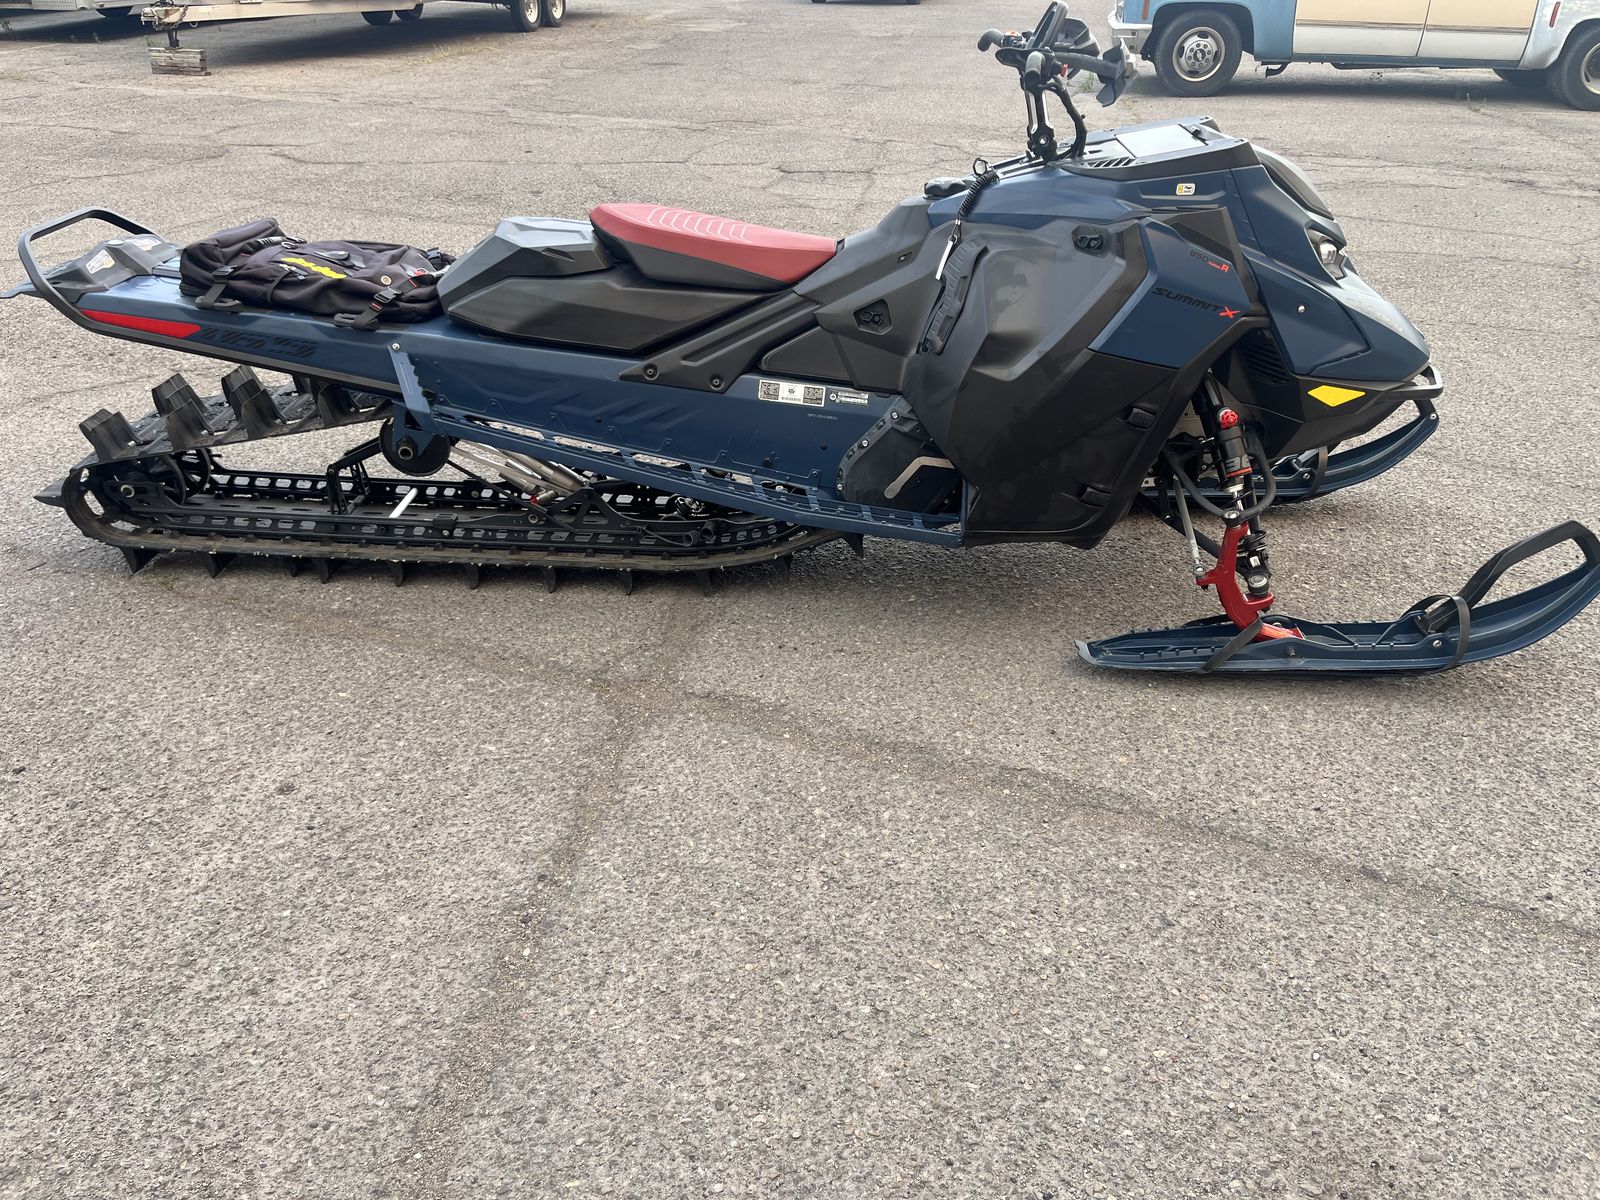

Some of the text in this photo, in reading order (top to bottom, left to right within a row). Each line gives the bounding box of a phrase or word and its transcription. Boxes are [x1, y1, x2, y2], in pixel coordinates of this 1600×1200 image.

[1221, 264, 1230, 272] R
[1152, 287, 1241, 319] SUMMIT X
